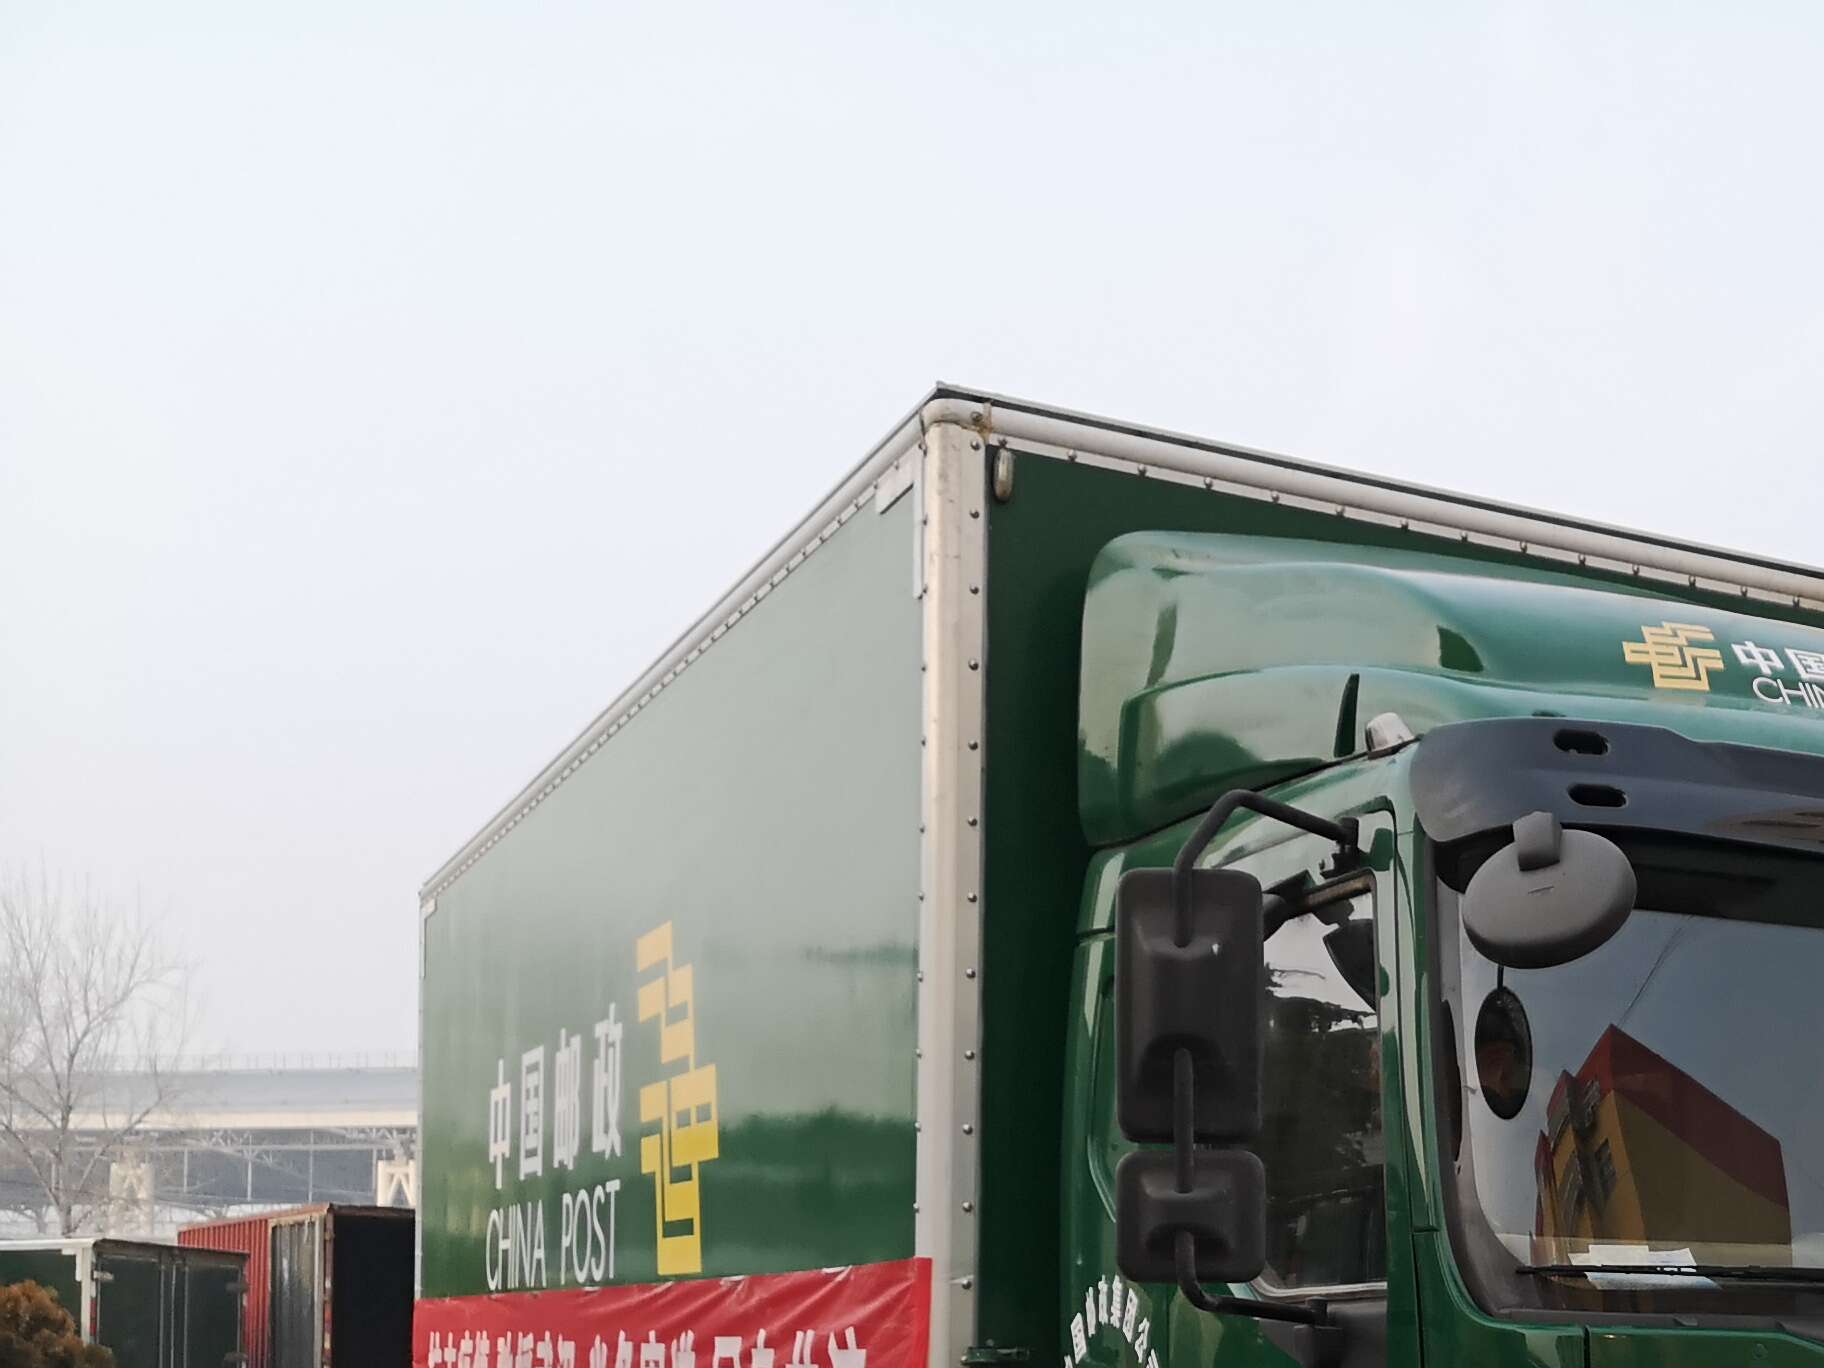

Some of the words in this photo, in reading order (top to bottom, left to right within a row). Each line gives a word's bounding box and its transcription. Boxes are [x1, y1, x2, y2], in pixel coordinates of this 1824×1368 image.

[489, 1002, 623, 1189] 中国邮政
[485, 1198, 546, 1291] CHINA
[561, 1180, 622, 1285] POST
